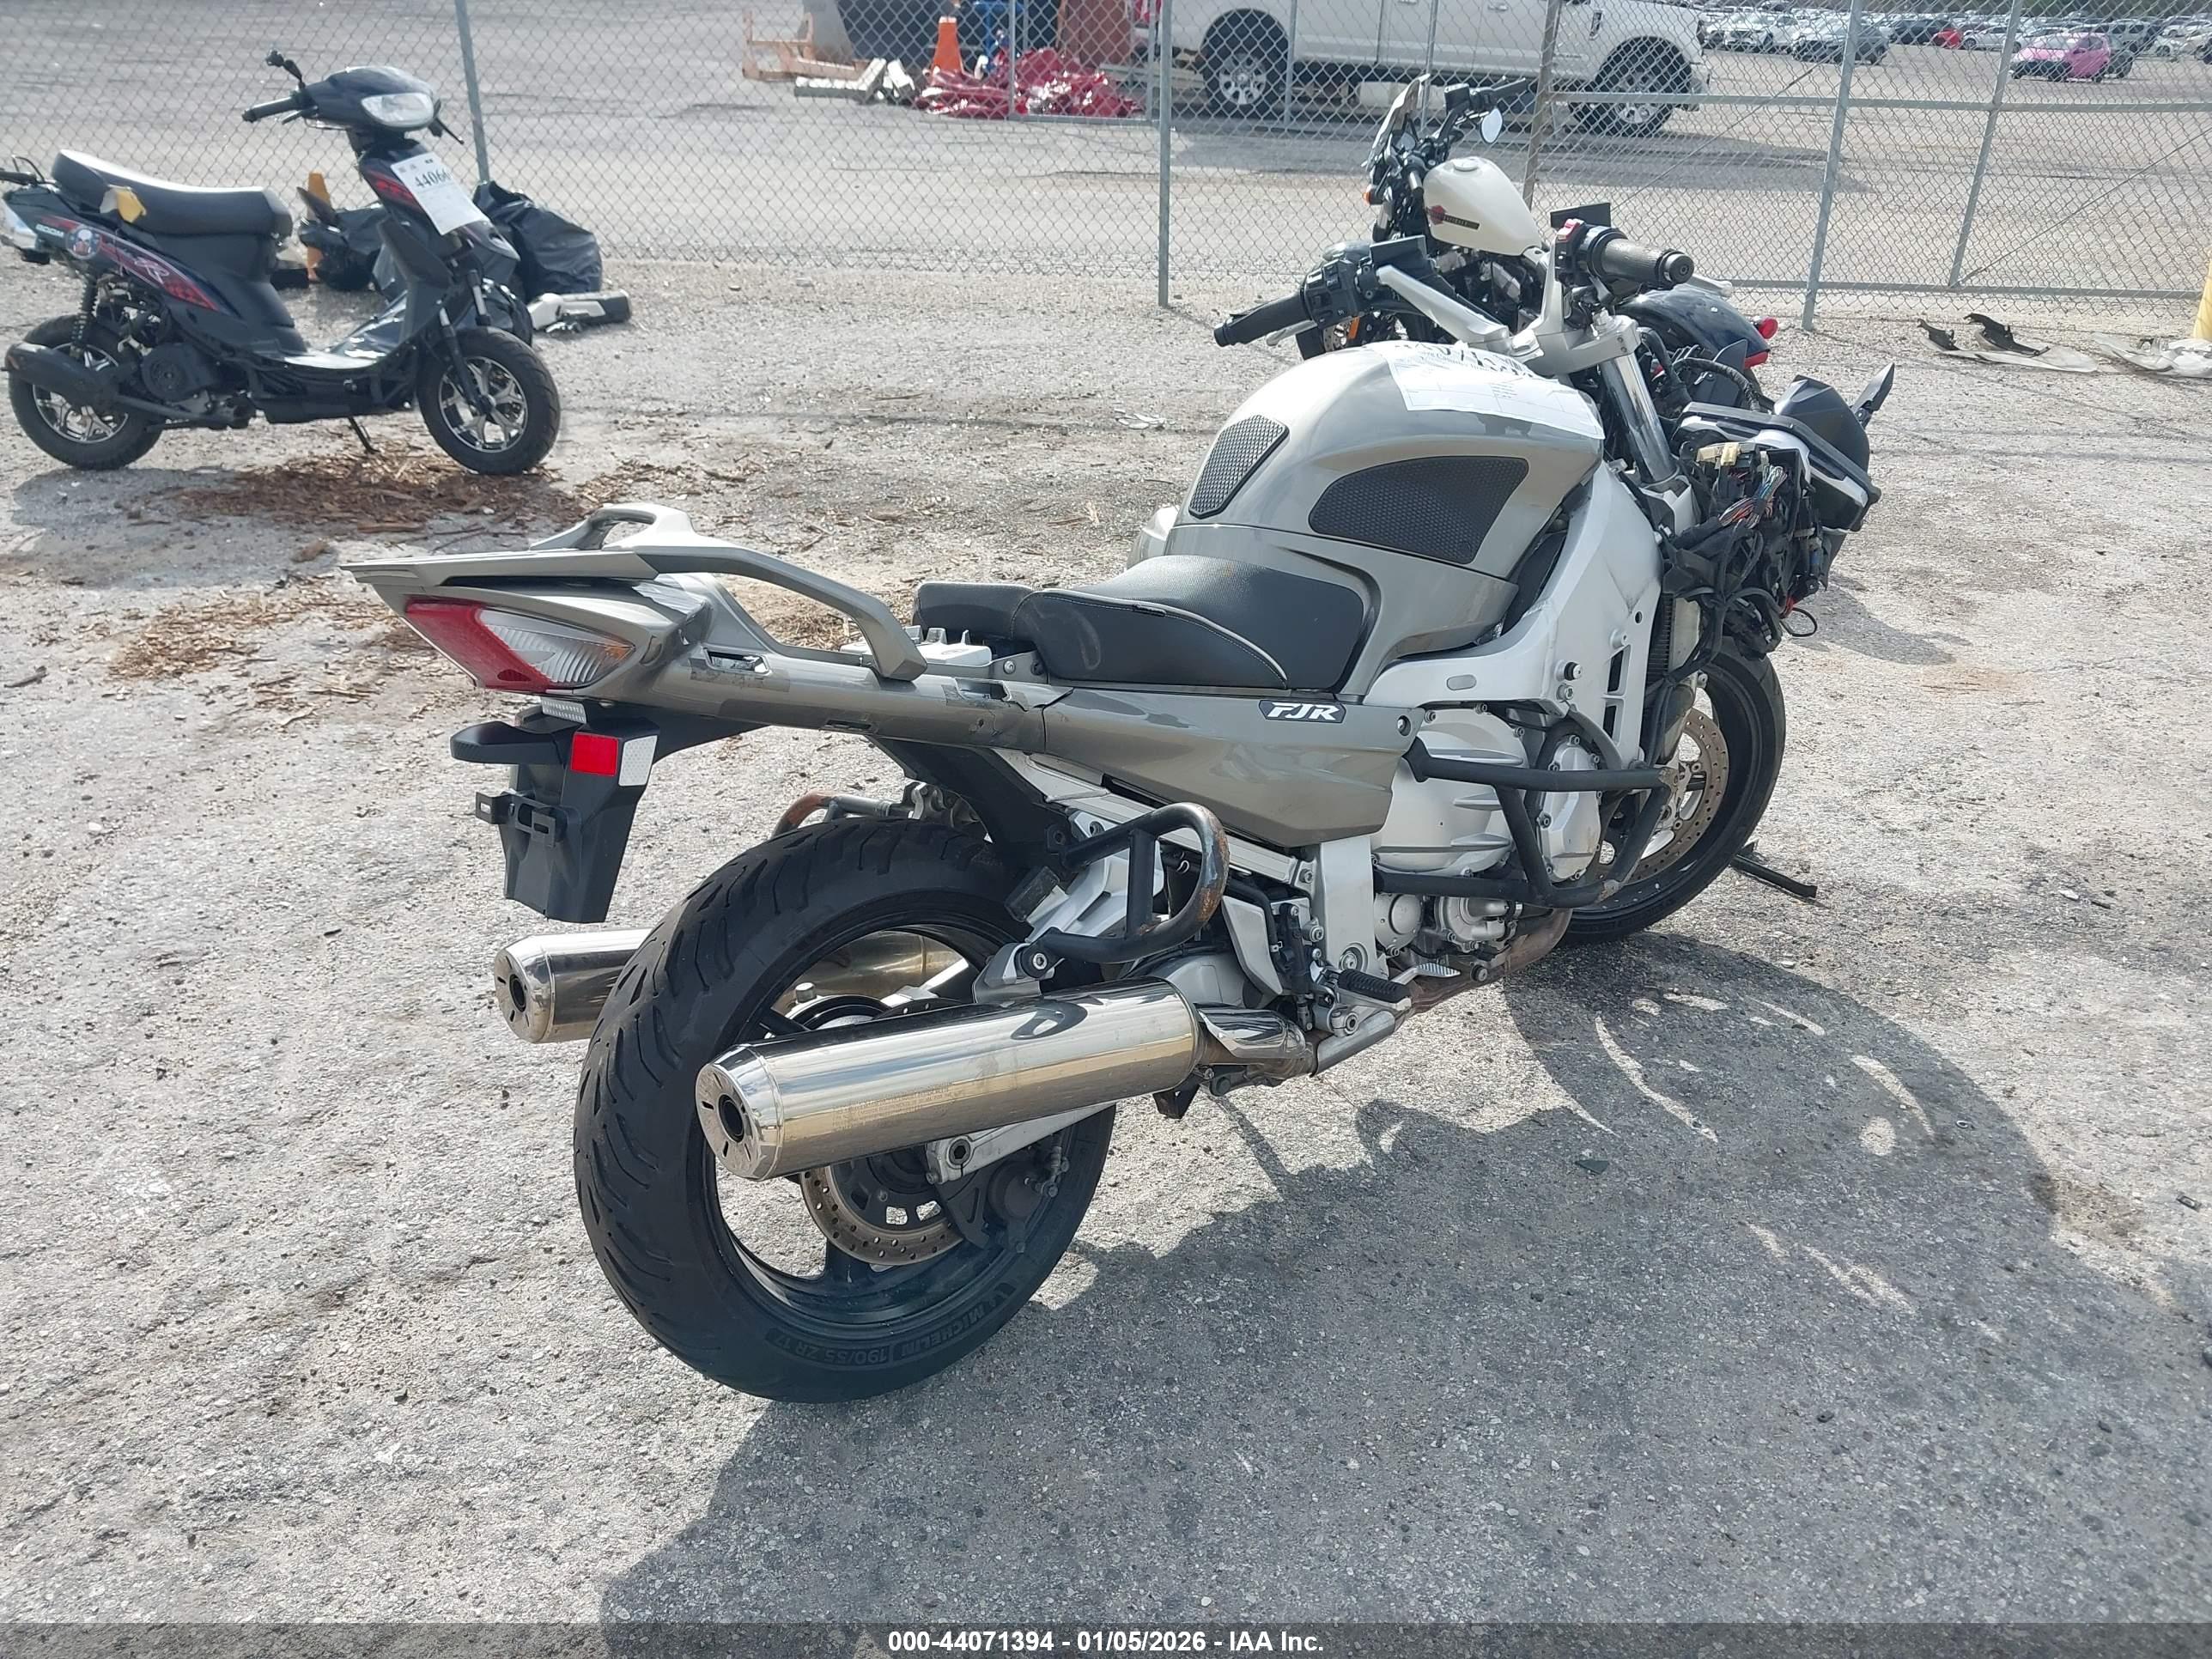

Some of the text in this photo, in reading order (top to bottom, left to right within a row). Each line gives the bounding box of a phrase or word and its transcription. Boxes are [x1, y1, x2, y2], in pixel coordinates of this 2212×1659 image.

[1267, 702, 1340, 720] FJR
[777, 1307, 985, 1364] MICHELIN 190/55 ZR 17
